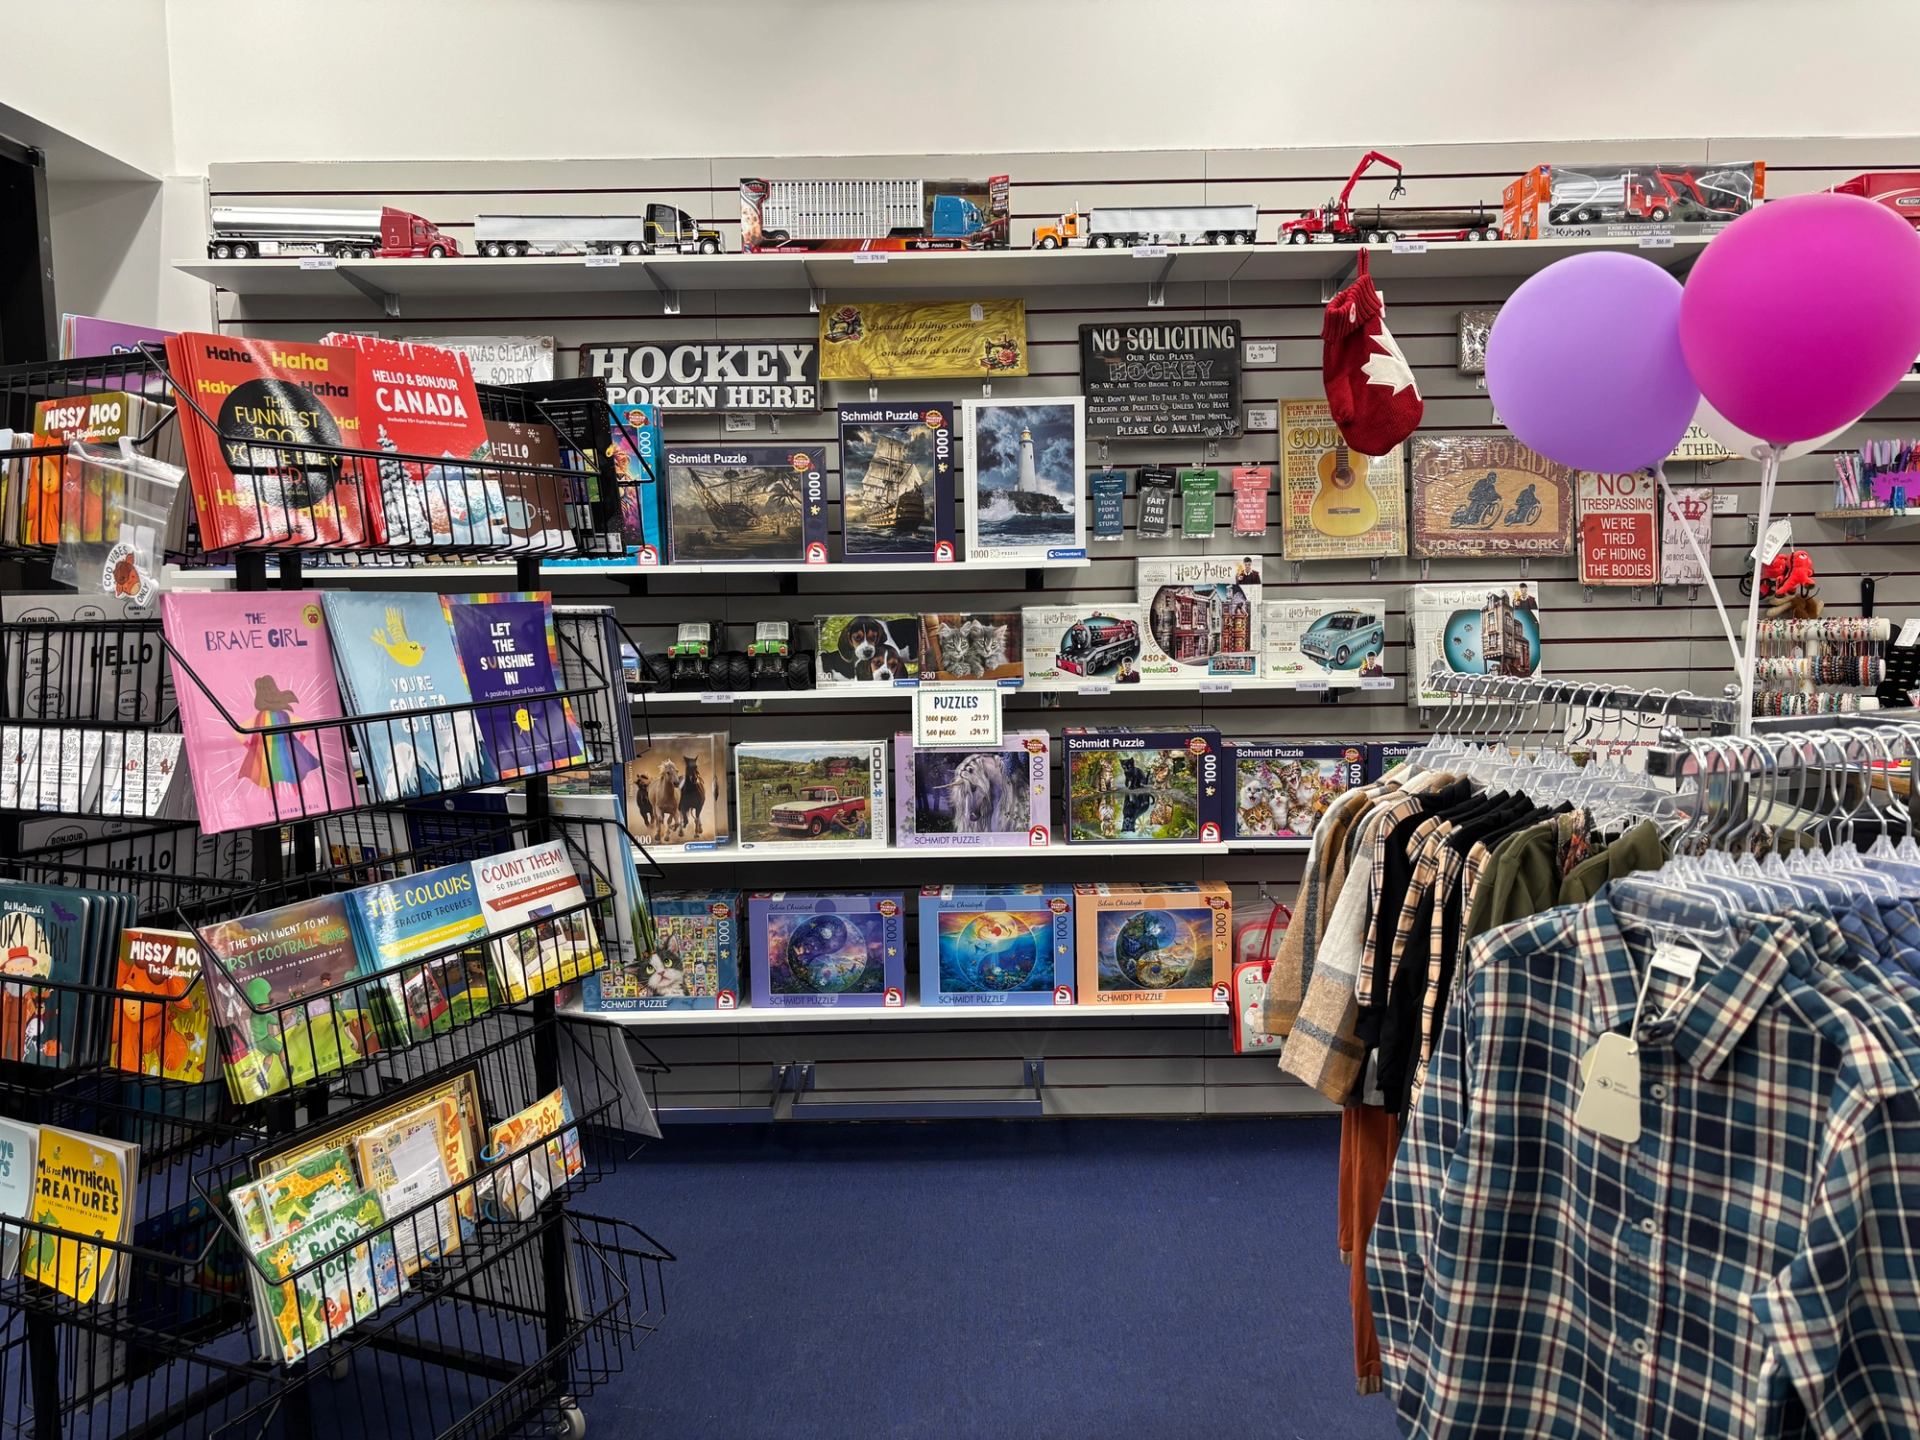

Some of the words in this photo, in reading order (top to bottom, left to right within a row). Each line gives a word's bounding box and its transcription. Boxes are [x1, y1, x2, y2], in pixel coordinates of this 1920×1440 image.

[1556, 228, 1591, 237] Kubota
[918, 321, 949, 332] things
[903, 333, 944, 345] together
[1092, 327, 1120, 352] NO
[1126, 325, 1236, 351] SOLICITING
[206, 346, 252, 363] Haha
[271, 351, 328, 371] Haha
[470, 346, 495, 362] WAS
[498, 345, 537, 362] CLEAN
[1126, 353, 1145, 361] OUR
[1149, 353, 1165, 361] KID
[1169, 353, 1194, 361] PLAYS
[590, 345, 814, 384] HOCKEY
[1109, 360, 1214, 381] HOCKEY
[372, 369, 404, 384] HELLO
[406, 374, 415, 386] &
[415, 374, 458, 391] BONJOUR
[491, 367, 533, 383] SORRY
[376, 388, 468, 418] CANADA
[727, 386, 815, 408] HERE
[44, 406, 83, 430] MISSY
[89, 403, 121, 424] MOO
[235, 406, 320, 428] FUNNIEST
[841, 411, 883, 421] Schmidt
[886, 411, 919, 421] Puzzle
[62, 430, 76, 441] The
[76, 427, 106, 441] Highland
[107, 426, 120, 436] Coo
[254, 427, 306, 441] BOOK
[1116, 424, 1149, 436] PLEASE
[1153, 424, 1167, 434] GO
[1171, 423, 1201, 434] AWAY!
[491, 442, 529, 459] HELLO
[640, 431, 651, 458] 1000
[937, 429, 949, 459] 1000
[669, 453, 711, 464] Schmidt
[714, 454, 747, 464] Puzzle
[808, 471, 821, 502] 1000
[1597, 474, 1635, 495] NO
[1146, 497, 1166, 506] FART
[1583, 498, 1652, 510] TRESPASSING
[1146, 506, 1164, 515] FREE
[1143, 515, 1165, 525] ZONE
[1601, 518, 1635, 529] WE'RE
[1429, 540, 1486, 550] FORCED
[1489, 539, 1510, 550] TO
[1512, 539, 1560, 549] WORK
[1603, 533, 1634, 545] TIRED
[108, 545, 128, 564] VIBES
[970, 550, 989, 559] 1000
[1592, 549, 1606, 560] OF
[1610, 548, 1646, 560] HIDING
[104, 565, 114, 587] COO
[1175, 564, 1203, 581] Harry
[1204, 562, 1232, 579] Potter
[1589, 564, 1608, 576] THE
[1612, 564, 1651, 576] BODIES
[136, 582, 150, 603] ONLY
[245, 613, 266, 625] THE
[490, 623, 511, 637] LET
[205, 631, 263, 651] BRAVE
[267, 628, 308, 648] GIRL
[493, 639, 515, 652] THE
[480, 654, 535, 670] SUNSHINE
[504, 671, 519, 685] IN!
[817, 672, 832, 680] 500
[921, 672, 936, 680] 500
[391, 676, 433, 693] YOU'RE
[430, 695, 446, 707] TO
[491, 690, 511, 698] positivity
[511, 688, 527, 697] journal
[934, 696, 979, 709] PUZZLES
[940, 714, 958, 724] piece
[939, 729, 956, 738] piece
[1069, 739, 1109, 748] Schmidt
[1113, 738, 1145, 748] Puzzle
[1236, 749, 1273, 757] Schmidt
[1275, 749, 1304, 757] Puzzle
[873, 747, 882, 788] 1000
[1034, 756, 1043, 780] 1000
[1205, 754, 1216, 783] 1000
[1350, 764, 1361, 784] 500
[51, 833, 83, 845] BONJOUR
[914, 835, 949, 844] SCHMIDT
[953, 835, 980, 844] PUZZLE
[482, 859, 524, 884] COUNT
[527, 849, 565, 872] THEM!
[496, 884, 505, 892] 50
[507, 877, 532, 889] TRACTOR
[533, 868, 560, 882] TROUBLES
[367, 894, 402, 917] THE
[405, 873, 472, 907] COLOURS
[4, 901, 12, 909] Old
[13, 902, 44, 914] MacDonald's
[395, 911, 432, 928] TRACTOR
[434, 898, 473, 916] TROUBLES
[229, 940, 248, 951] THE
[251, 933, 268, 946] DAY
[277, 923, 301, 938] WENT
[304, 920, 316, 930] TO
[317, 915, 329, 926] MY
[719, 920, 729, 946] 1000
[886, 918, 897, 941] 1000
[1057, 916, 1067, 941] 1000
[1215, 912, 1226, 938] 1000
[35, 917, 69, 963] FARM
[257, 936, 318, 963] FOOTBALL
[319, 927, 346, 944] GAME
[130, 941, 171, 963] MISSY
[148, 963, 160, 974] The
[162, 965, 192, 979] Highland
[600, 1000, 636, 1010] SCHMIDT
[639, 999, 668, 1008] PUZZLE
[770, 996, 805, 1006] SCHMIDT
[807, 995, 838, 1005] PUZZLE
[939, 995, 974, 1004] SCHMIDT
[976, 994, 1005, 1003] PUZZLE
[1097, 994, 1132, 1003] SCHMIDT
[1135, 993, 1163, 1002] PUZZLE
[525, 1107, 557, 1132] BUSY
[38, 1158, 46, 1175] M
[61, 1165, 118, 1197] MYTHICAL
[309, 1225, 361, 1261] BUSY
